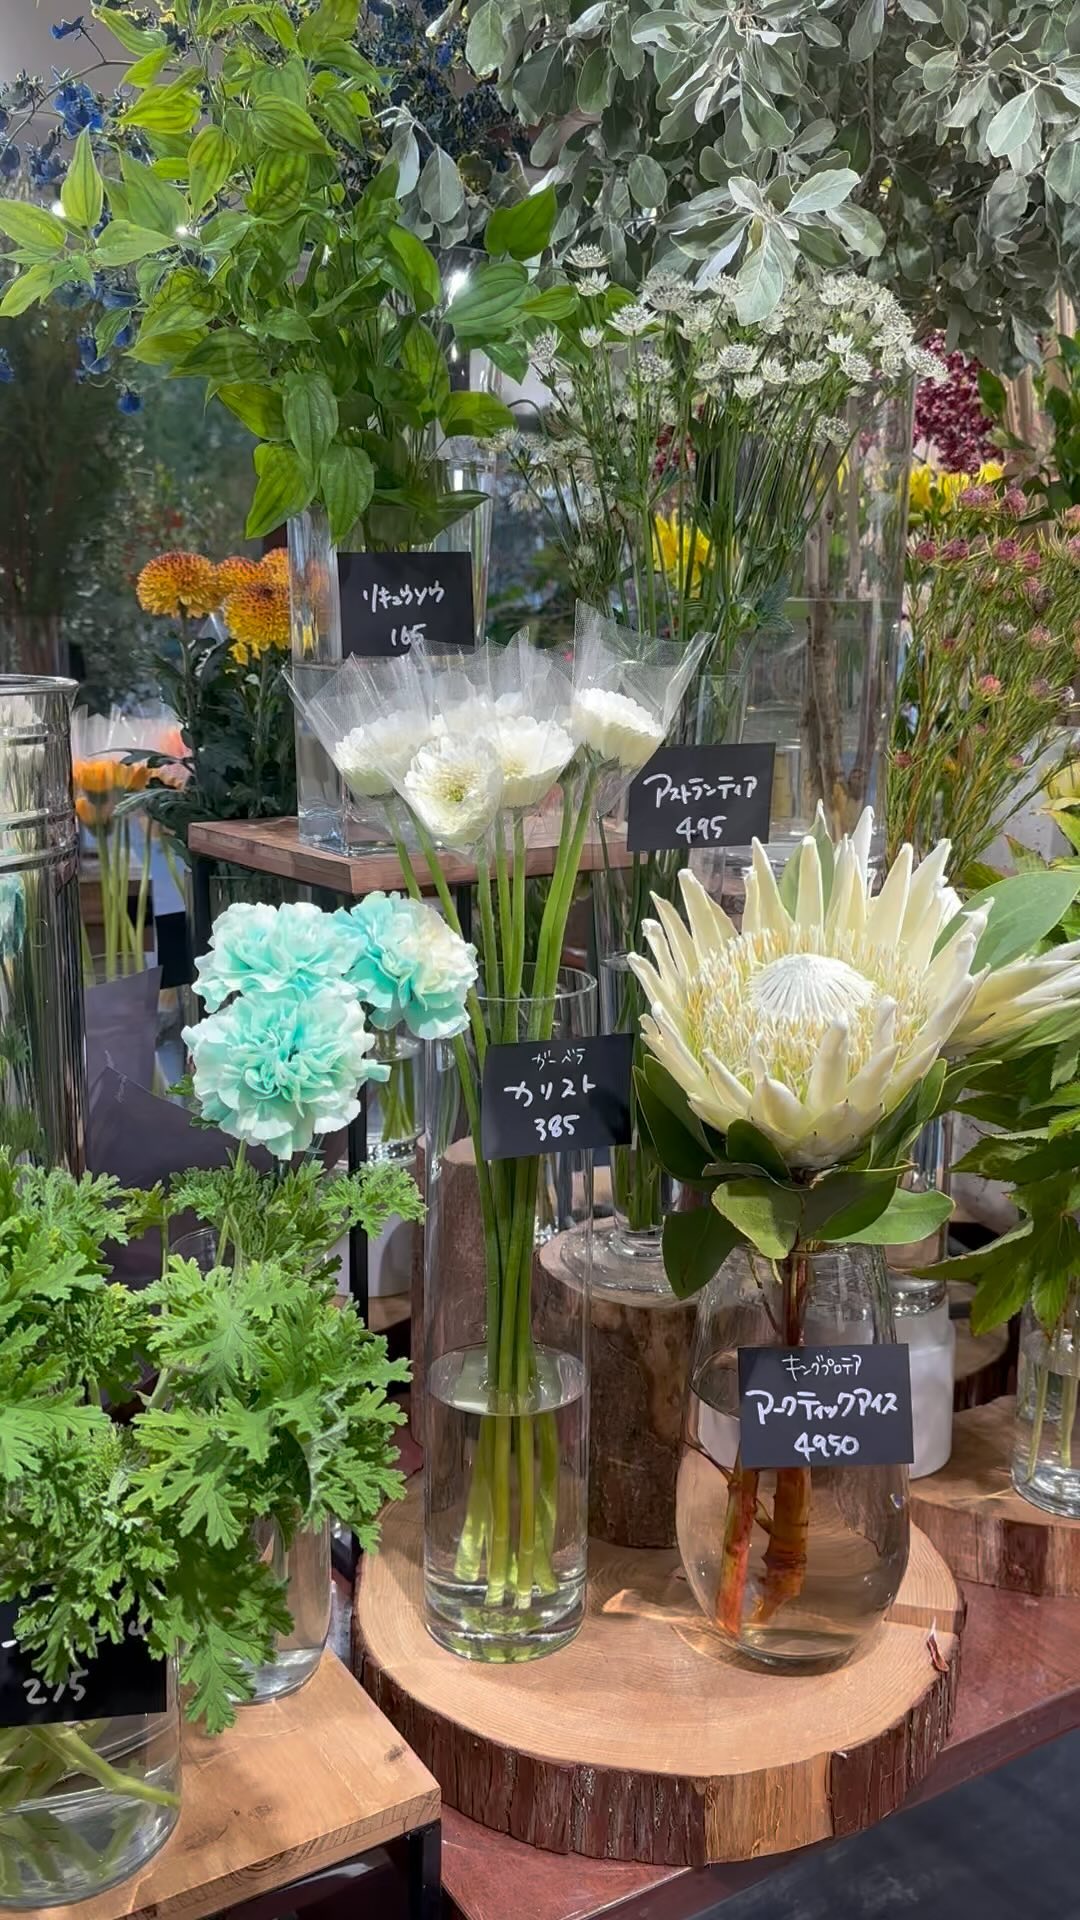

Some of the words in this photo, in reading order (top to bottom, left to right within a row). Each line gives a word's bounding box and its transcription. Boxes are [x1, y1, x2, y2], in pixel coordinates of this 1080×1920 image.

[391, 623, 427, 646] 165
[642, 773, 758, 808] アストランティア
[675, 816, 727, 844] 495
[531, 1048, 586, 1071] ガーベラ
[503, 1074, 596, 1107] カリスト
[534, 1114, 580, 1141] 385
[782, 1354, 862, 1381] キングプロテア
[745, 1387, 898, 1425] アークティックアイス
[793, 1431, 860, 1462] 4950
